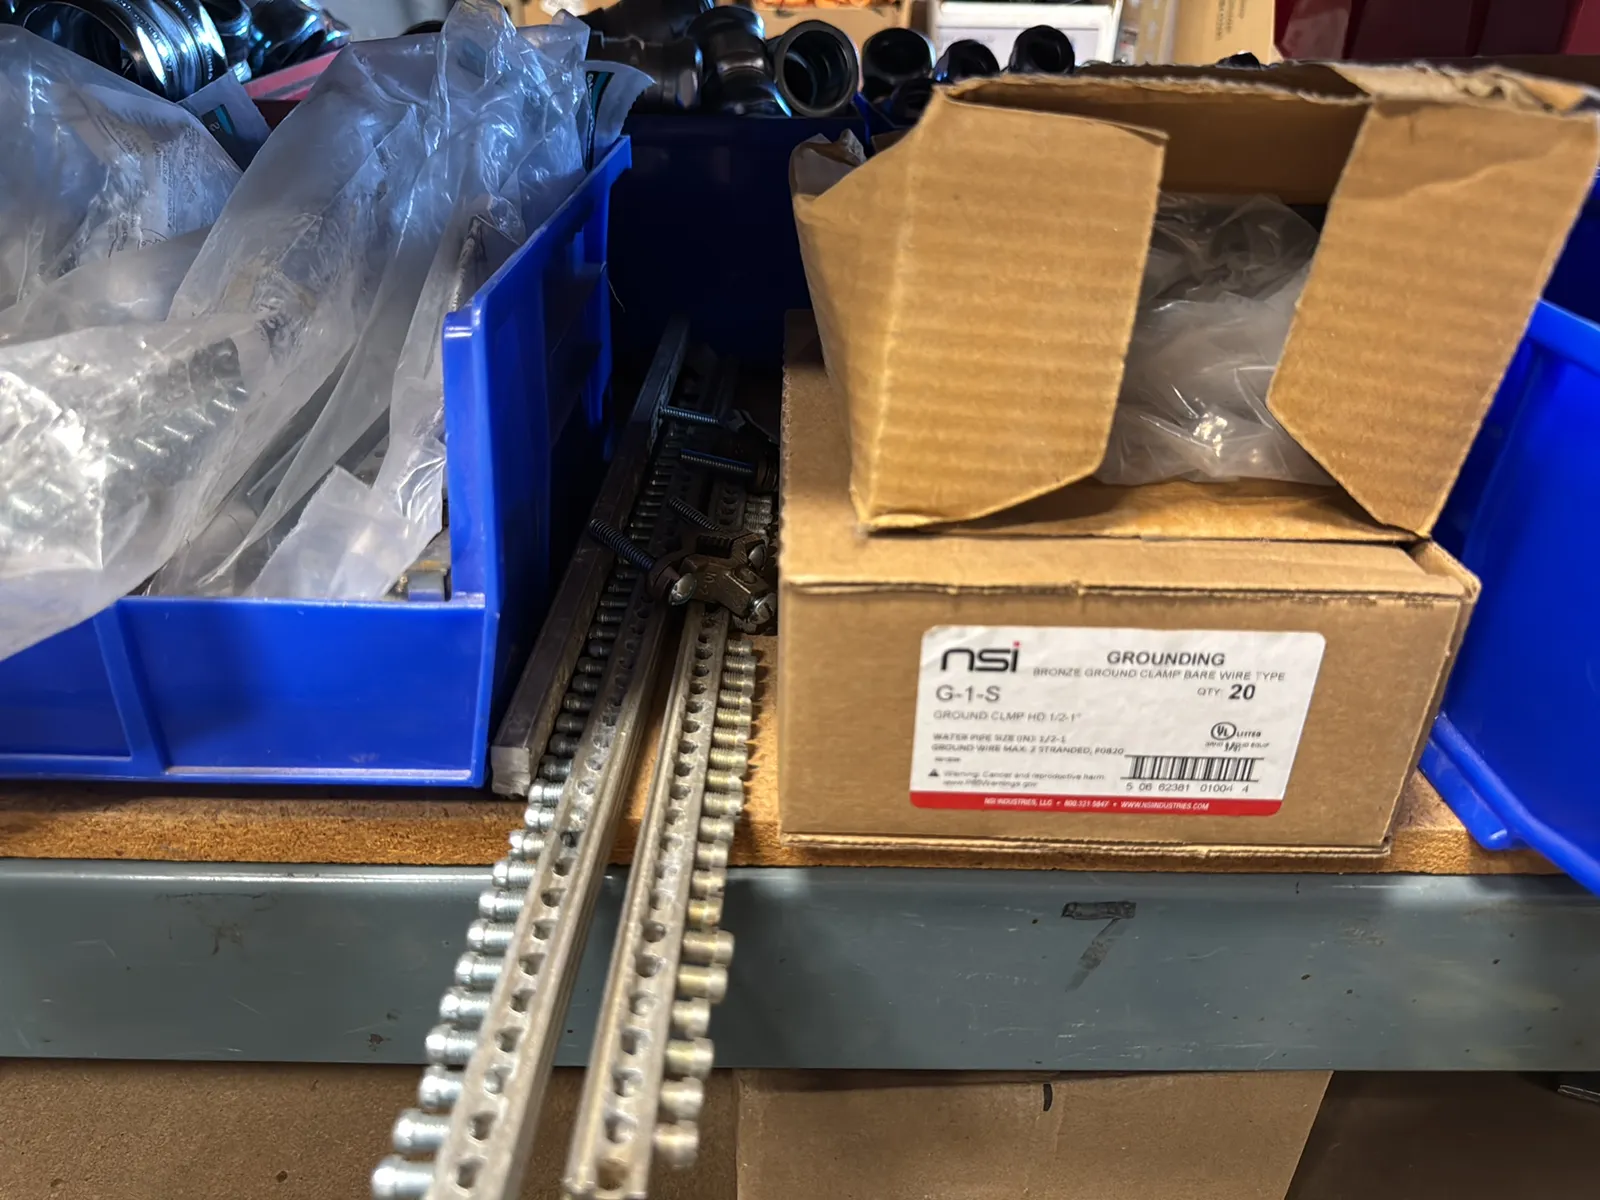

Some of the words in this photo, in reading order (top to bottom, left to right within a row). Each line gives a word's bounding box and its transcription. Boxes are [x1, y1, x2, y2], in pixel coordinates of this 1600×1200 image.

[941, 641, 1020, 673] nsi
[1107, 651, 1226, 666] GROUNDING
[1033, 667, 1081, 677] BRONZE
[1084, 669, 1137, 678] GROUND
[1140, 670, 1181, 679] CLAMP
[1184, 671, 1216, 680] BARE
[1219, 672, 1251, 681] WIRE
[1256, 672, 1286, 681] TYPE
[936, 685, 1001, 702] G-1-S
[1228, 684, 1256, 701] 20
[934, 710, 988, 720] GROUND
[991, 712, 1024, 721] CLMP
[933, 733, 967, 741] WATER
[994, 734, 1015, 742] SIZE
[931, 744, 974, 752] GROUND
[977, 745, 1001, 753] WIRE
[1125, 782, 1134, 791] 5
[1138, 782, 1152, 791] 06
[1158, 782, 1190, 792] 62381
[1199, 783, 1233, 793] 01004
[1242, 784, 1250, 793] 4
